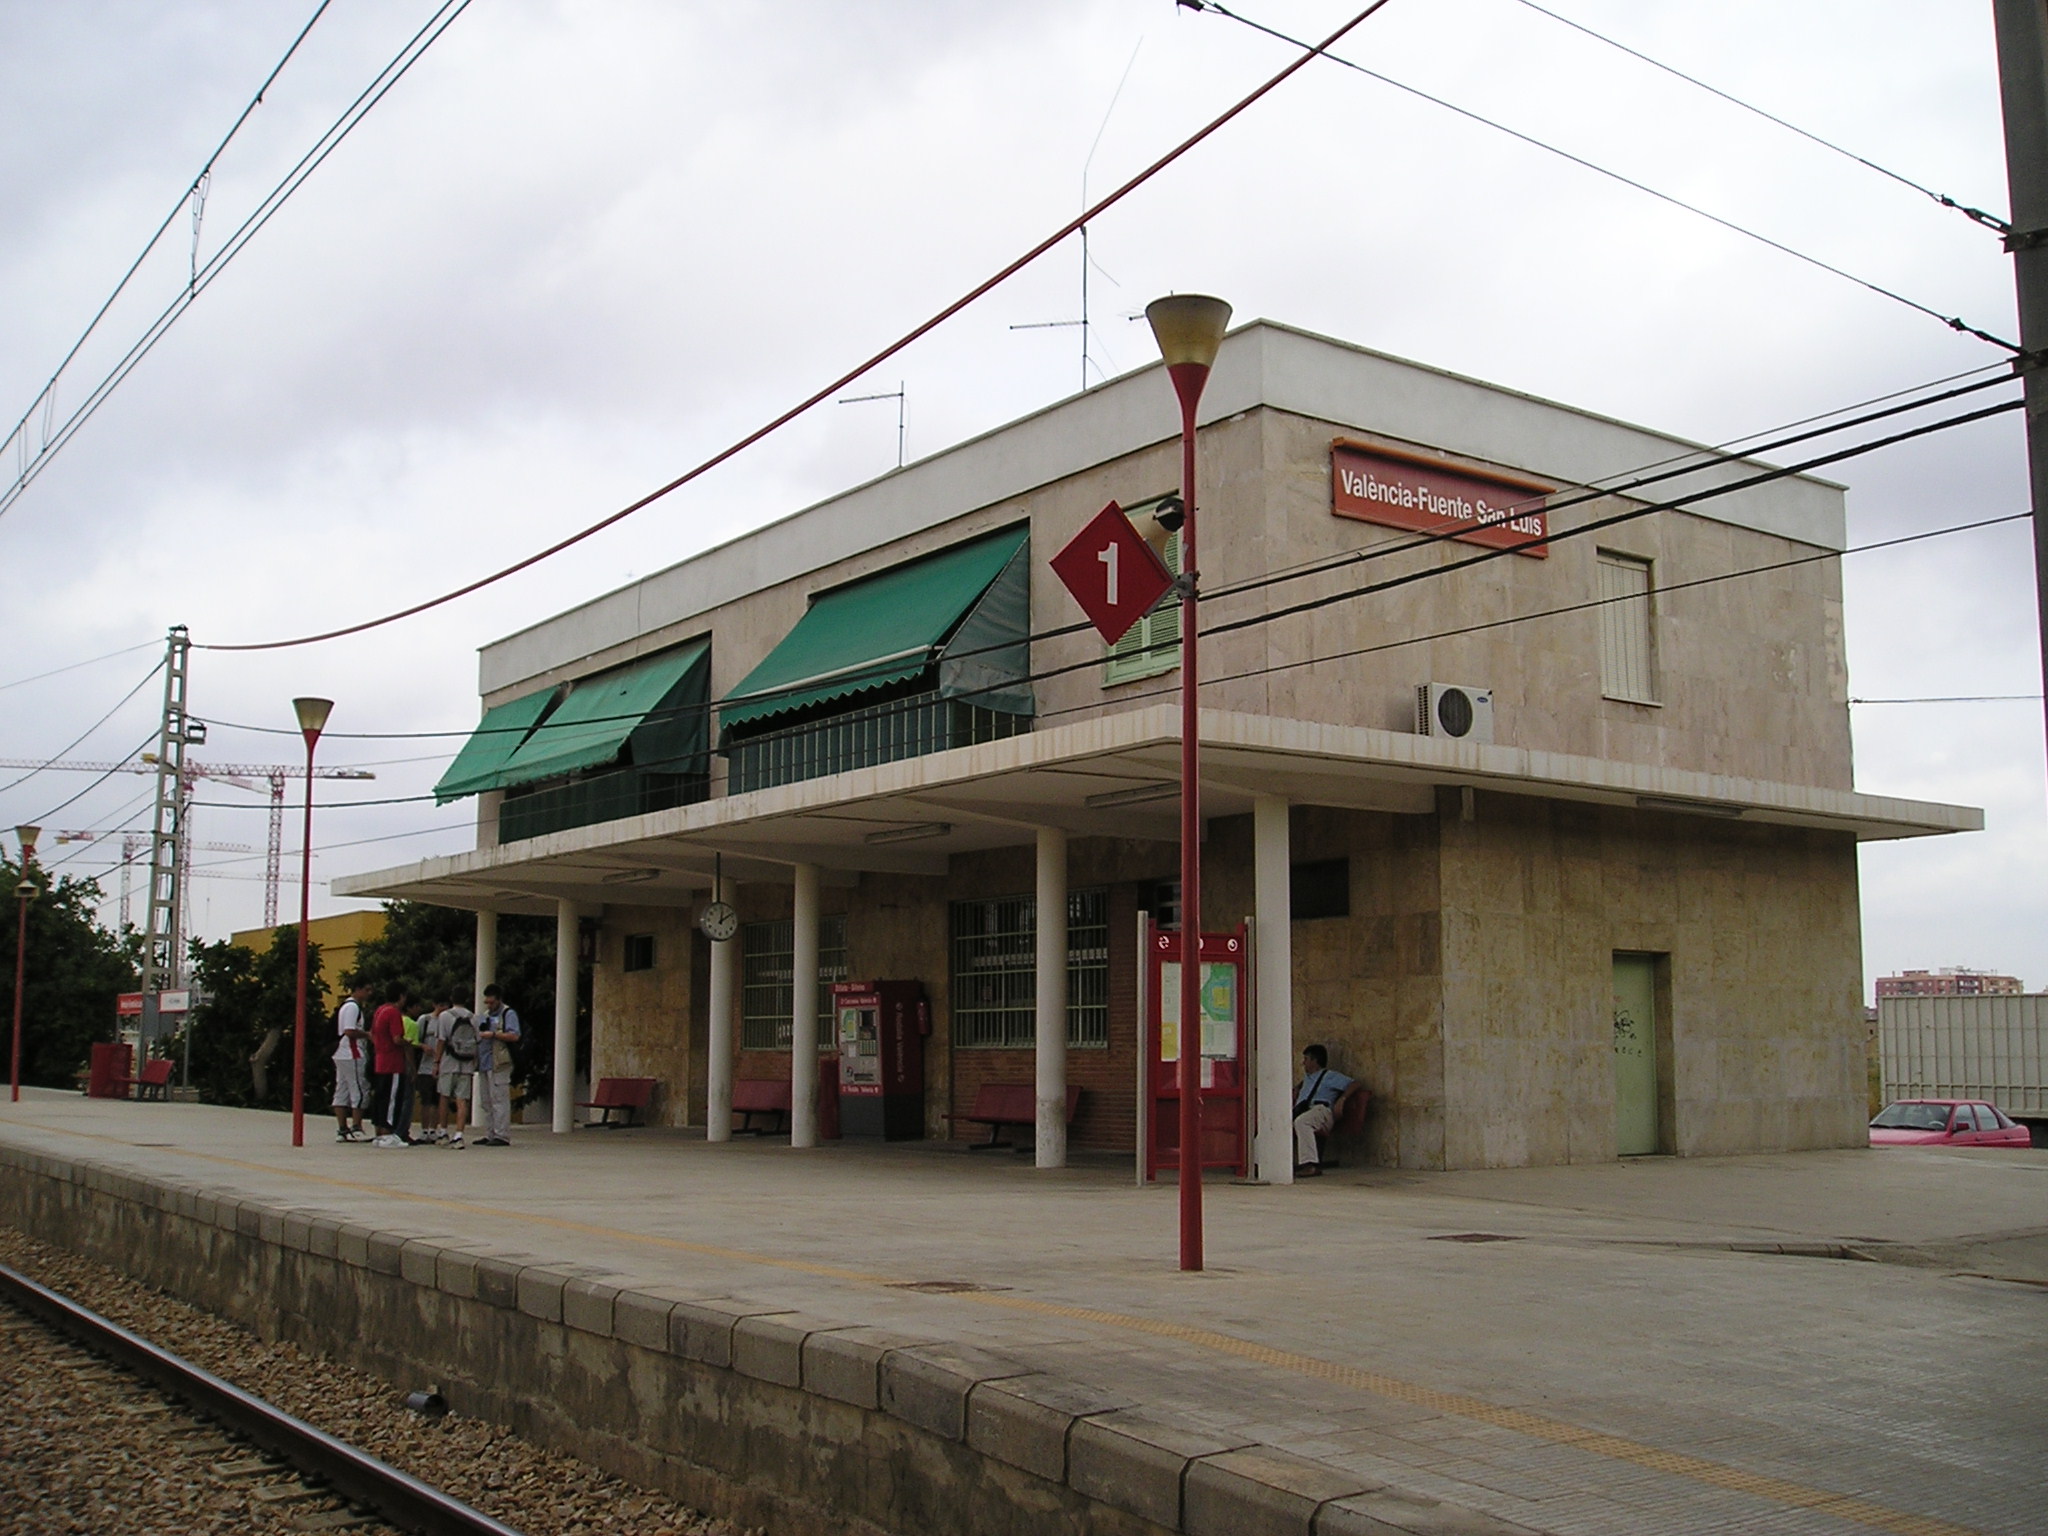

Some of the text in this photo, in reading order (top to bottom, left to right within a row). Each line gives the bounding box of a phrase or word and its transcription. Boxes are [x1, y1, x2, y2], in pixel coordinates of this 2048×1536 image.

[1341, 468, 1542, 536] València-Fuente San Luis
[1097, 541, 1118, 605] 1
